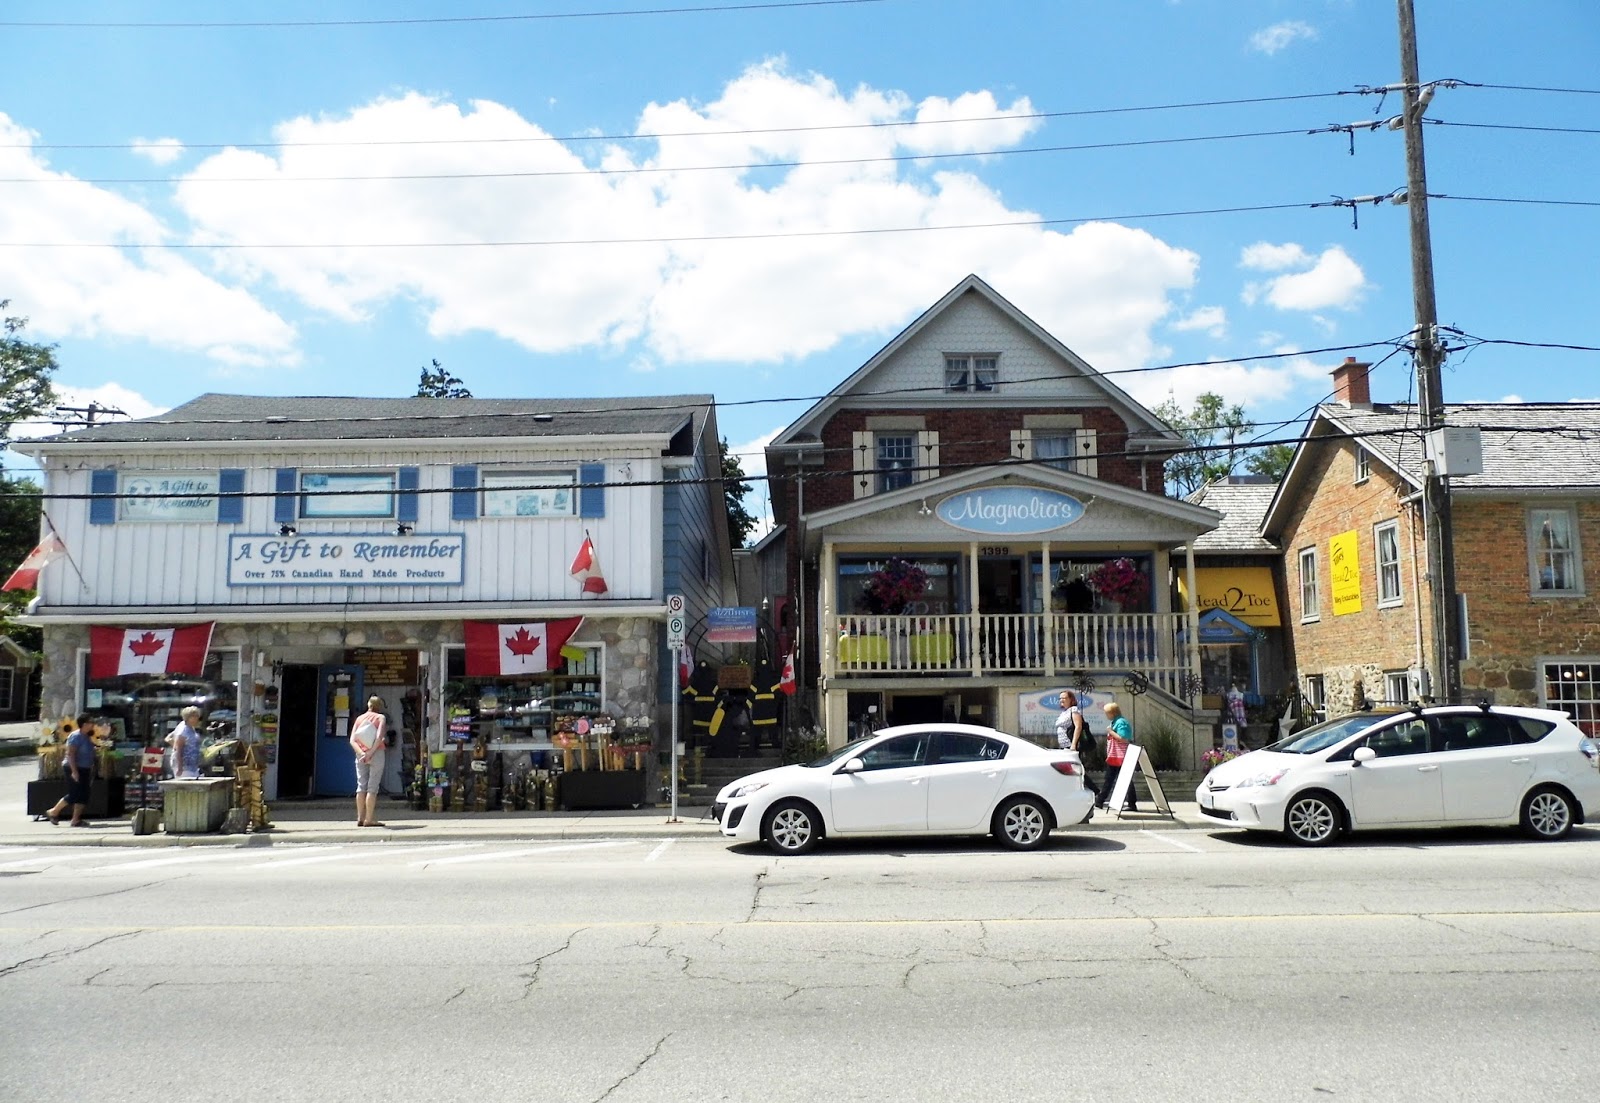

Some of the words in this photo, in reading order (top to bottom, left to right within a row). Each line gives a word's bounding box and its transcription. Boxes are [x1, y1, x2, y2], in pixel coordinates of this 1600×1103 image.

[159, 480, 169, 491] A
[172, 479, 193, 493] Gift
[197, 479, 208, 490] to
[157, 496, 213, 509] Remember
[948, 495, 1072, 525] Magnolia's
[235, 542, 252, 561] A
[260, 538, 312, 564] Gift
[319, 542, 343, 559] to
[353, 538, 460, 563] Remember
[980, 547, 1010, 556] 1399
[244, 570, 265, 579] Over
[271, 570, 286, 579] 75%
[291, 569, 334, 579] Canadian
[339, 569, 364, 579] Hand
[372, 569, 398, 579] Made
[405, 569, 446, 579] Products
